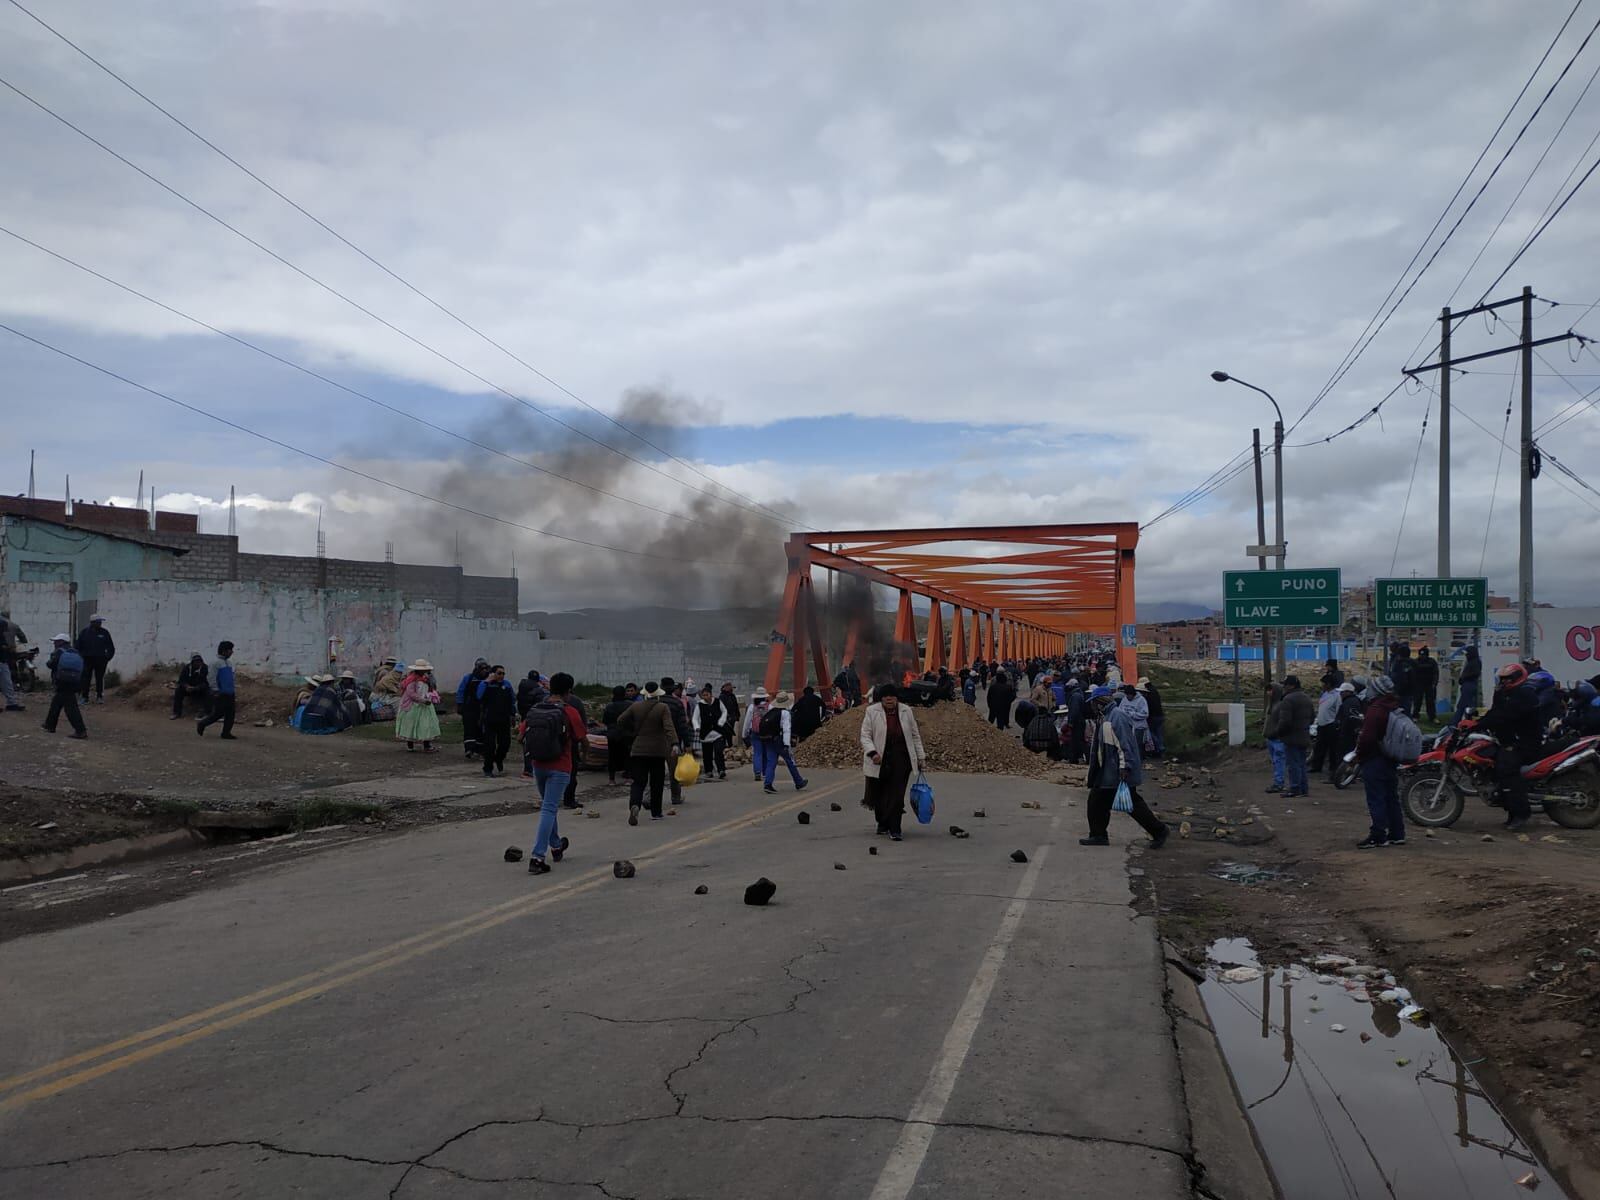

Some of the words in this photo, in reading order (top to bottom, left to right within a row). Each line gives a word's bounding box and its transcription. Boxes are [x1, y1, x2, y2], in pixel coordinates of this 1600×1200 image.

[1281, 578, 1327, 591] PUNO
[1386, 584, 1433, 596] PUENTE
[1439, 584, 1475, 596] ILAVE
[1386, 600, 1433, 609] LONGITUD
[1437, 600, 1453, 609] 180
[1456, 600, 1476, 609] MTS
[1235, 605, 1280, 617] ILAVE
[1385, 612, 1410, 622] CARGA
[1462, 612, 1477, 622] TON
